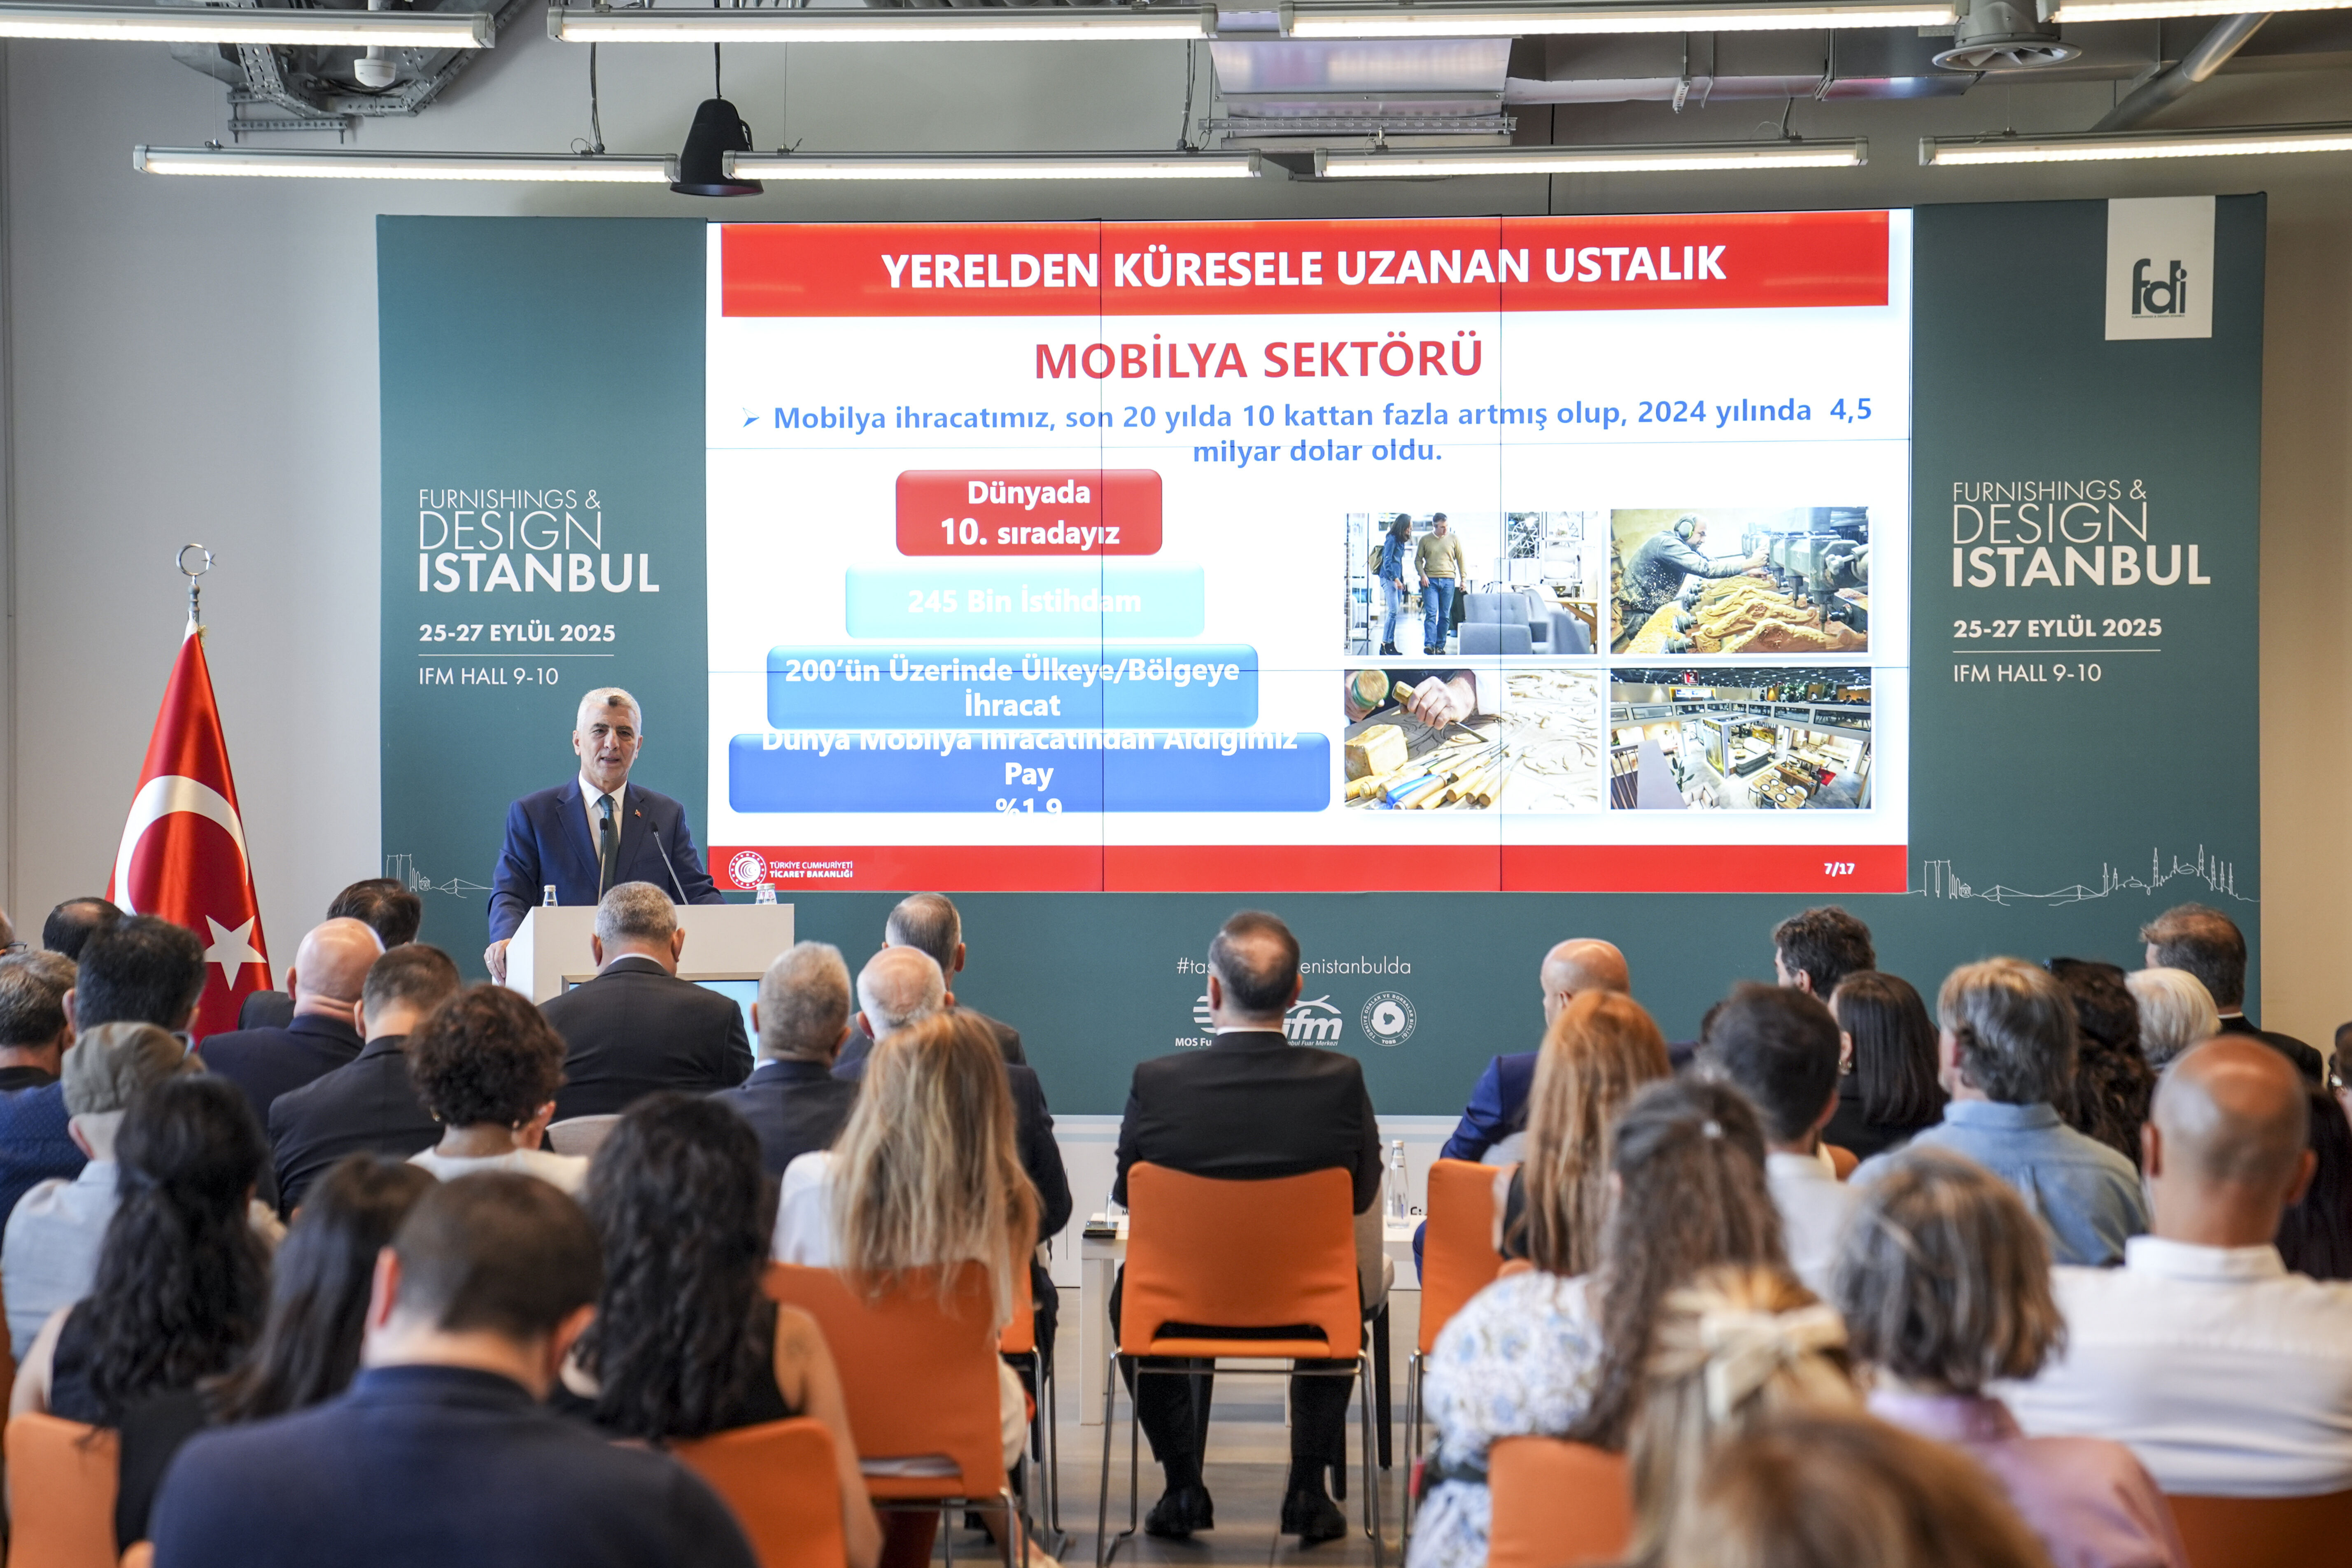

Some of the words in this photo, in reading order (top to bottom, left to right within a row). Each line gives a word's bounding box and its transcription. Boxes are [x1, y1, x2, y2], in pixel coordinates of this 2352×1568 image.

[881, 253, 1098, 289] YERELDEN
[1114, 244, 1322, 288] KÜRESELE
[1338, 249, 1529, 285] UZANAN
[1546, 245, 1727, 282] USTALIK
[2132, 258, 2187, 315] fdi
[1036, 333, 1248, 379] MOBİLYA
[1264, 330, 1482, 377] SEKTÖRÜ
[775, 406, 885, 435] Mobilya
[896, 405, 1056, 431] ihracatımız,
[1066, 408, 1113, 428] son
[1124, 406, 1156, 428] 20
[1165, 404, 1231, 434] yılda
[1244, 405, 1274, 426] 10
[1285, 403, 1373, 426] kattan
[1383, 402, 1448, 426] fazla
[1458, 404, 1547, 431] artmış
[1557, 401, 1627, 430] olup,
[1638, 401, 1706, 423] 2024
[1716, 398, 1811, 429] yılında
[1830, 398, 1872, 425] 4,5
[1193, 440, 1281, 468] milyar
[1290, 439, 1363, 461] dolar
[1372, 438, 1442, 461] oldu.
[420, 489, 577, 509] FURNISHINGS
[585, 489, 601, 509] &
[968, 479, 1091, 510] Dünyada
[1954, 480, 2121, 502] FURNISHINGS
[2129, 479, 2147, 499] &
[420, 510, 601, 551] DESIGN
[941, 518, 988, 545] 10.
[997, 520, 1120, 550] sıradayız
[1953, 502, 2147, 544] DESIGN
[419, 552, 660, 593] ISTANBUL
[1953, 544, 2211, 588] ISTANBUL
[907, 589, 957, 613] 245
[967, 589, 1012, 613] Bin
[1021, 585, 1142, 613] İstihdam
[419, 624, 484, 642] 25-27
[490, 619, 555, 642] EYLÜL
[560, 624, 615, 642] 2025
[1953, 620, 2021, 638] 25-27
[2028, 614, 2097, 638] EYLÜL
[2103, 618, 2162, 637] 2025
[420, 667, 454, 685] IFM
[462, 667, 508, 685] HALL
[513, 667, 559, 685] 9-10
[889, 654, 1013, 682] Üzerinde
[1021, 654, 1240, 688] Ülkeye/Bölgeye
[1954, 664, 1991, 682] IFM
[1998, 664, 2047, 682] HALL
[2053, 664, 2102, 682] 9-10
[965, 689, 1061, 717] İhracat
[1005, 762, 1054, 792] Pay
[769, 860, 801, 869] TÜRKİYE
[802, 860, 853, 869] CUMHURİYETİ
[769, 869, 805, 878] TİCARET
[807, 869, 853, 878] BAKANLIĞI
[1824, 862, 1855, 877] 7/17
[1364, 995, 1381, 1013] ODALAR
[1392, 994, 1414, 1017] BORSALAR
[1175, 1037, 1198, 1047] MOS
